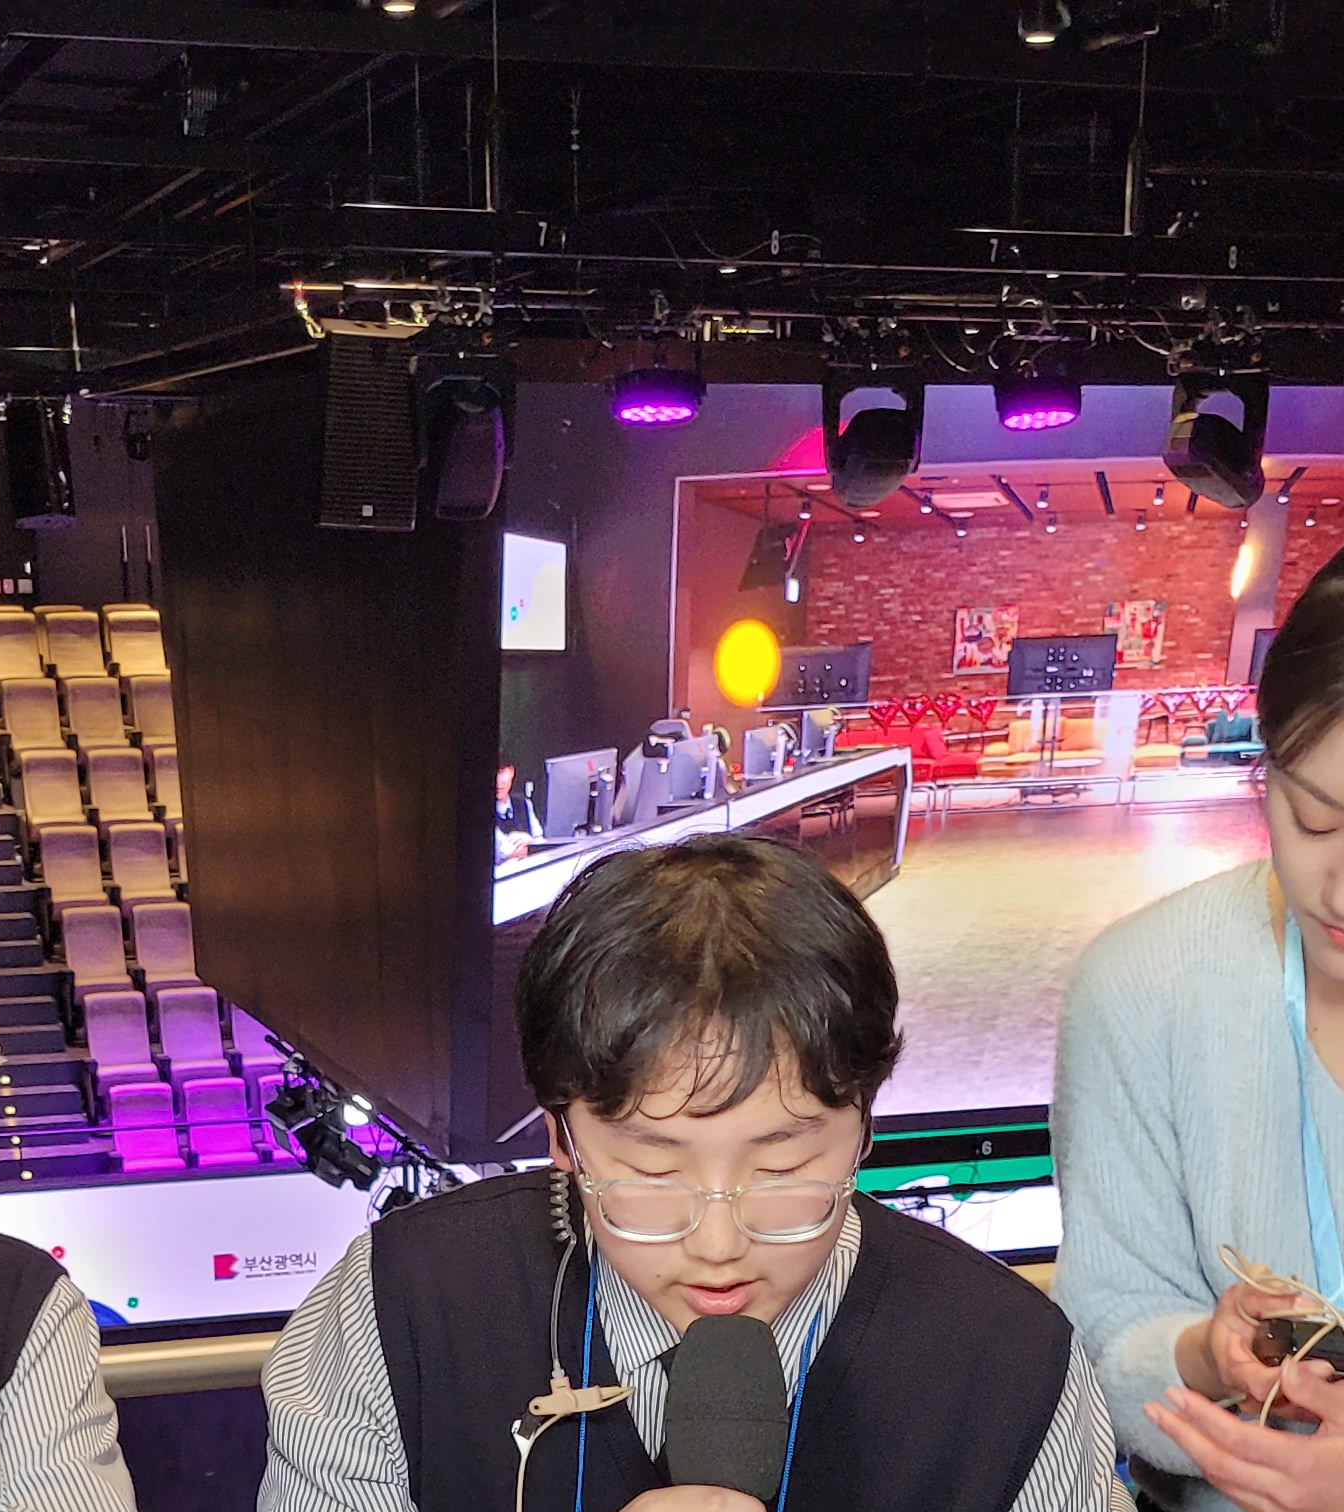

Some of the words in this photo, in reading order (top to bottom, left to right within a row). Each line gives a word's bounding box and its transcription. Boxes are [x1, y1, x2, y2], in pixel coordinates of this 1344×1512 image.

[538, 221, 547, 247] 7
[770, 230, 779, 255] 8
[990, 238, 998, 263] 7
[1228, 245, 1237, 269] 8
[243, 1251, 317, 1271] 부산광역시
